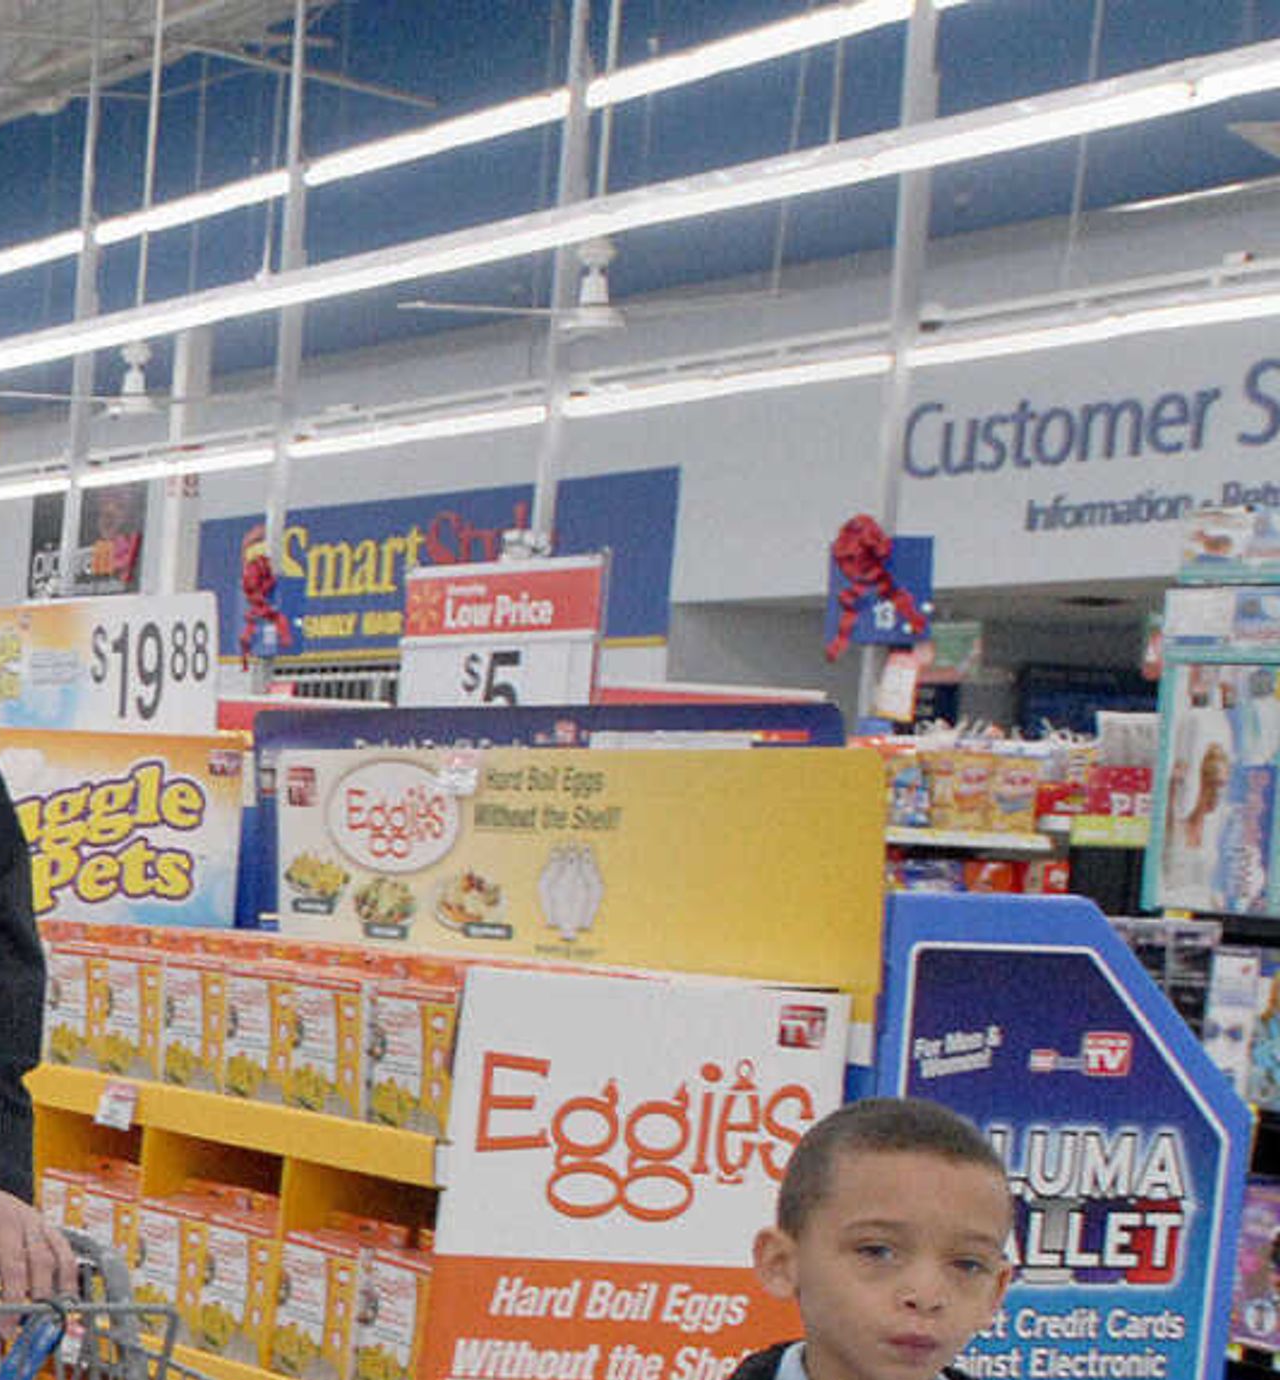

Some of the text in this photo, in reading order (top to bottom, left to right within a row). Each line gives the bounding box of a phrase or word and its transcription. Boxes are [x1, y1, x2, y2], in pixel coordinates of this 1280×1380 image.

[903, 387, 1220, 478] Customer
[1025, 489, 1192, 531] Information
[279, 524, 426, 598] Smart
[444, 590, 554, 629] Low Price
[346, 784, 447, 859] Eggies
[475, 1050, 816, 1224] Eggies
[489, 1275, 750, 1334] Hard Boil Eggs
[1015, 1308, 1099, 1340] Credit
[1106, 1308, 1186, 1340] Cards
[1030, 1348, 1168, 1379] Electronic
